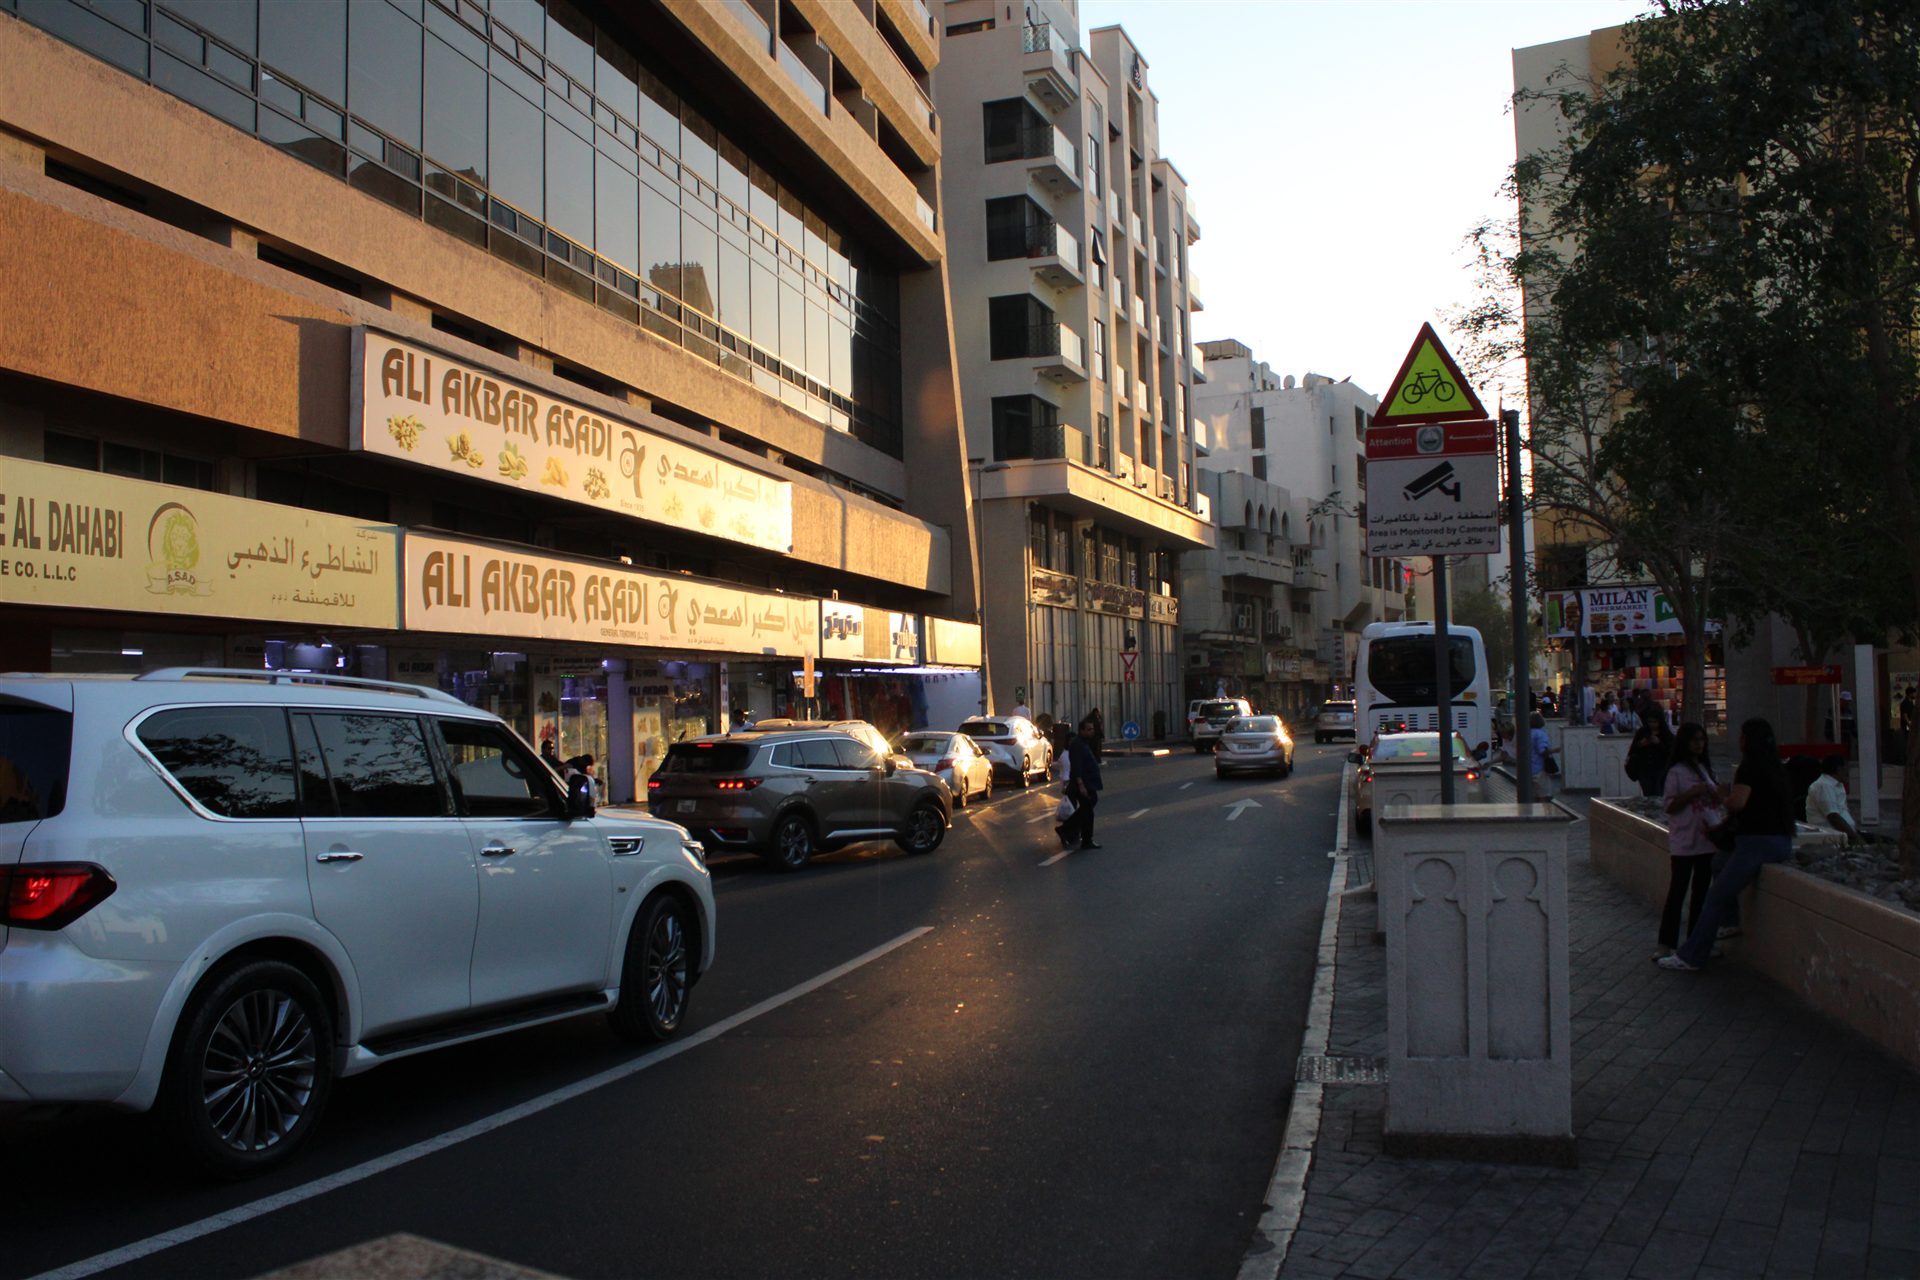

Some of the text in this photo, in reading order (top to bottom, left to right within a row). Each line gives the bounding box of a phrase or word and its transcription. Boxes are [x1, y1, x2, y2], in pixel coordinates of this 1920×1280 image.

[381, 347, 612, 462] ALI AKBAR ASADI
[1369, 436, 1413, 447] Attention
[12, 495, 41, 550] AL
[48, 500, 123, 560] DAHABI
[1369, 524, 1498, 537] Area is Monitored by Cameras
[226, 536, 295, 579] الذهبي
[14, 560, 38, 578] CO.
[43, 563, 76, 582] L.L.C
[167, 570, 197, 586] ASAD
[422, 550, 649, 627] ALI AKBAR ASADI
[1589, 590, 1649, 606] MILAN
[1589, 604, 1649, 613] SUPERMARKET
